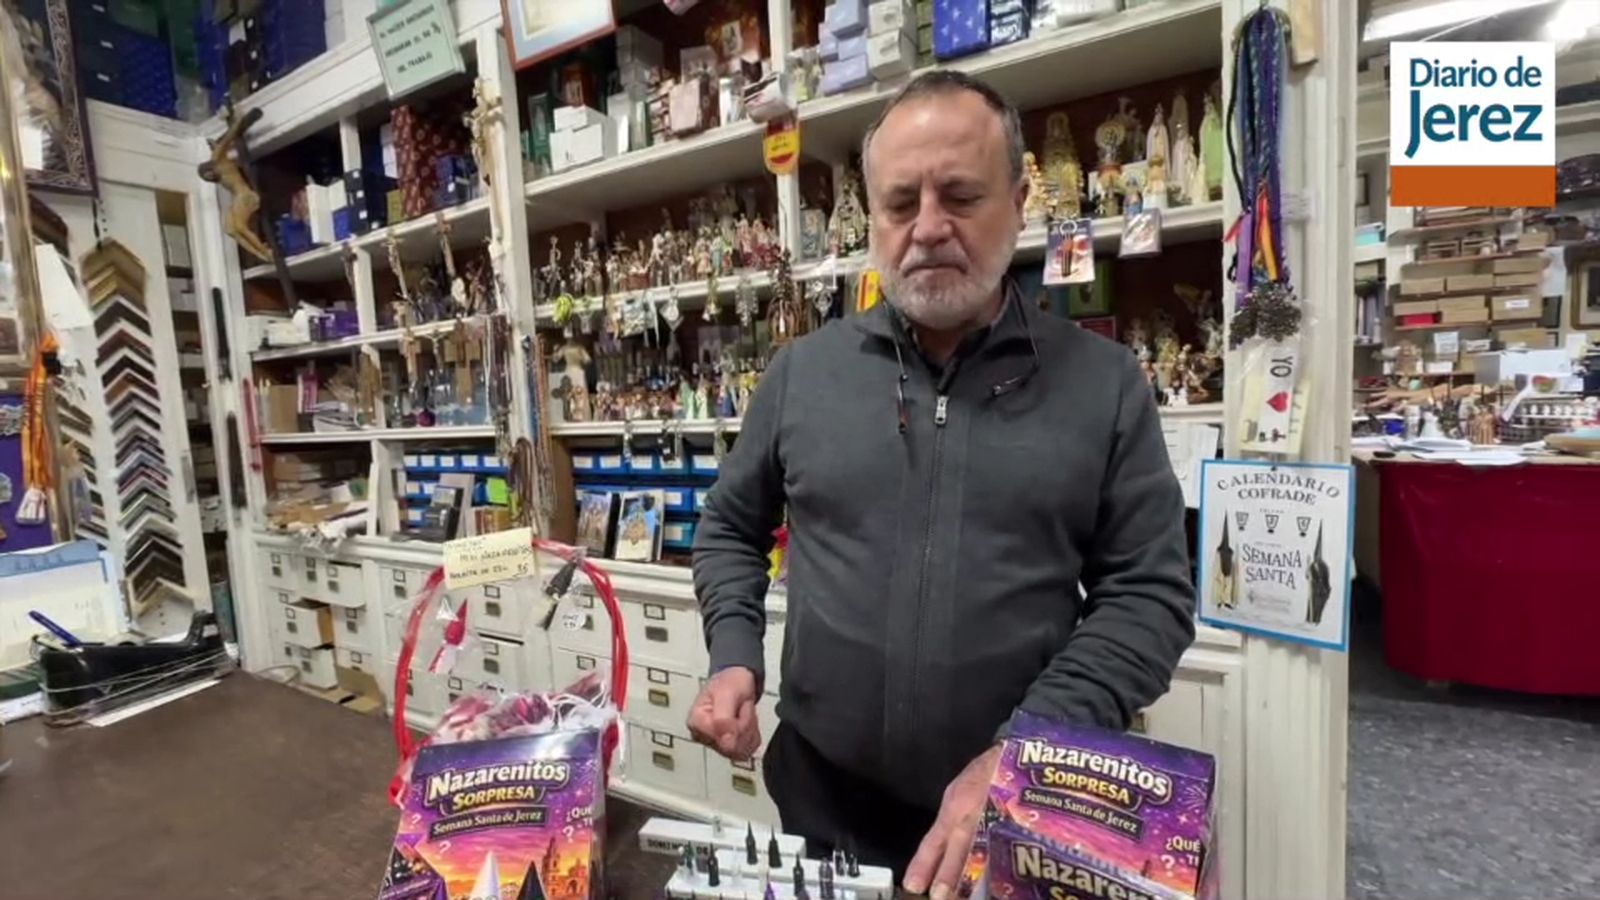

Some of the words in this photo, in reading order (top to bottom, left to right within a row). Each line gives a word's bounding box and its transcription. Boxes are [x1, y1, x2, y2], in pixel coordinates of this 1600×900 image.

[1217, 472, 1340, 499] CALENDARIO
[1237, 487, 1317, 506] COFRADE
[1242, 543, 1302, 568] SEMANA
[1245, 567, 1296, 589] SANTA
[428, 762, 567, 801] Nazarenitos
[1022, 740, 1168, 797] Nazarenitos
[452, 785, 536, 810] SORPRESA
[1043, 767, 1131, 805] SORPRESA
[433, 818, 474, 835] Semana
[474, 814, 502, 827] Santa
[514, 810, 542, 823] Jerez
[1024, 790, 1063, 809] Semana
[1063, 797, 1093, 817] Santa
[1093, 808, 1105, 821] de
[1105, 811, 1138, 833] Jerez
